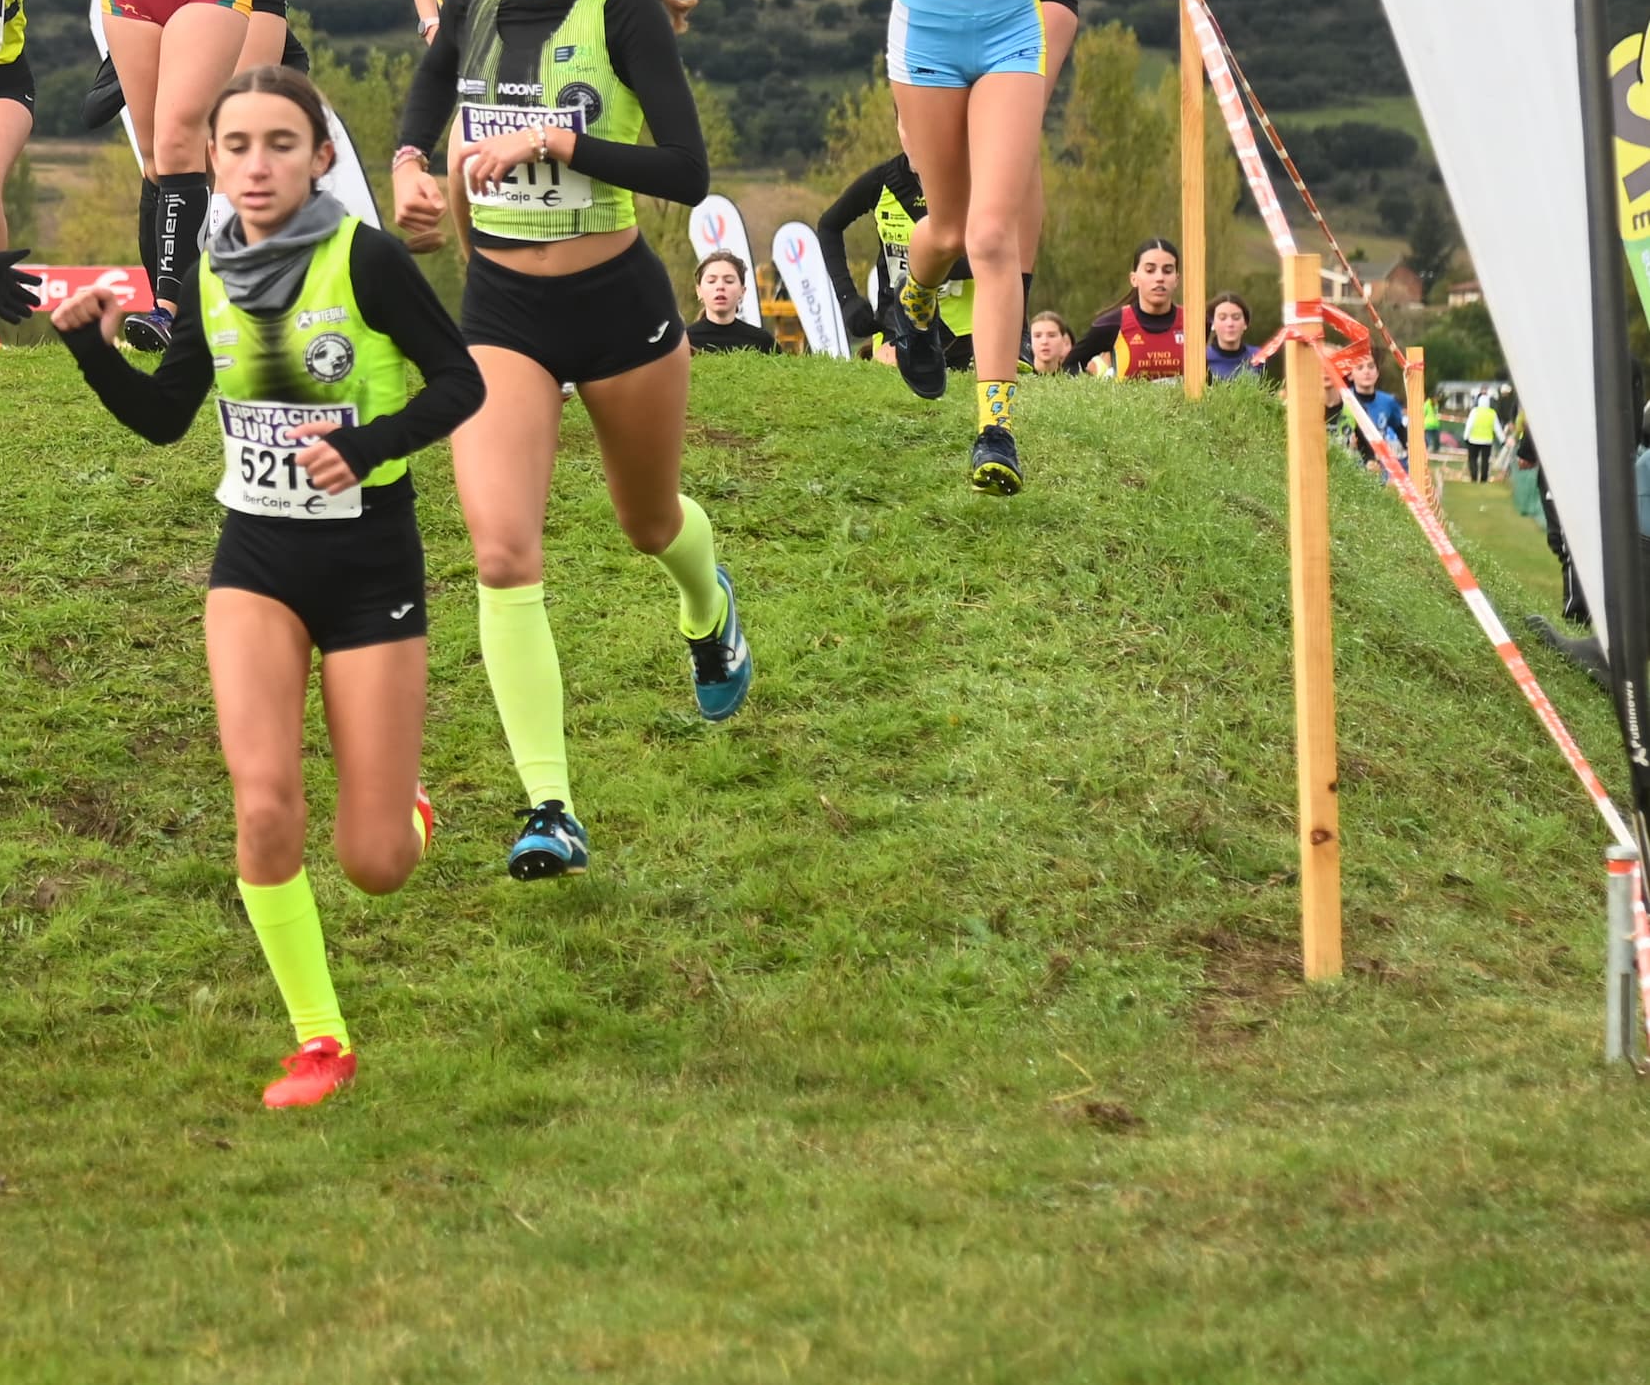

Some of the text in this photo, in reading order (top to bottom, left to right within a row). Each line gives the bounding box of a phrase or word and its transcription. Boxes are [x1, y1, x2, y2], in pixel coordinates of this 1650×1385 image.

[497, 82, 544, 96] NOONE
[1146, 350, 1172, 359] VINO
[1137, 358, 1181, 368] DE TORO
[229, 416, 322, 447] BURG
[240, 445, 317, 492] 521
